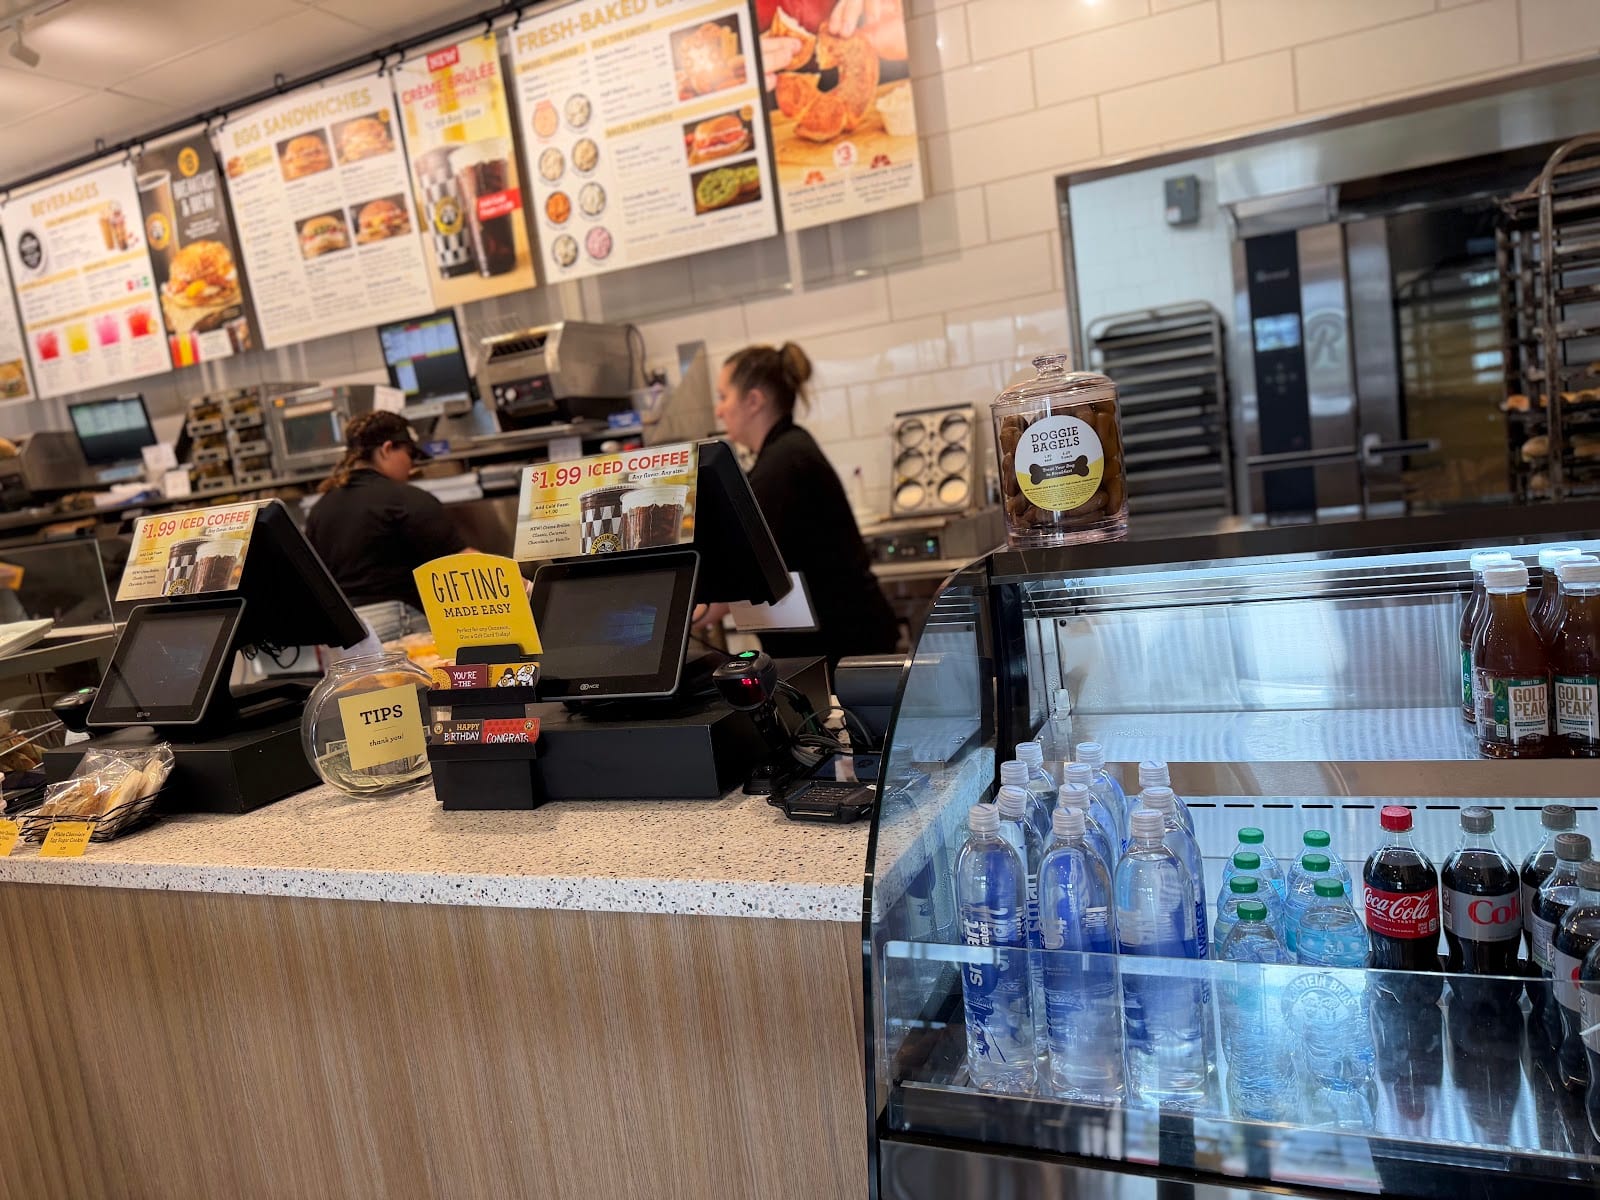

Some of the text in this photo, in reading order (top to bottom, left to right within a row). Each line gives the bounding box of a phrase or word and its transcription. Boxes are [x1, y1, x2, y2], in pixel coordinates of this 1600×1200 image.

[232, 86, 372, 149] EGG SANDWICHES
[31, 181, 99, 218] BEVERAGES
[1031, 426, 1079, 443] DOGGIE
[1032, 437, 1080, 453] BAGELS
[531, 450, 690, 489] $1.99 ICED COFFEE
[143, 510, 250, 539] $1.99 ICED COFFEE
[431, 567, 510, 603] GIFTING
[443, 603, 511, 617] MADE EASY
[453, 670, 478, 680] YOU'RE
[1513, 687, 1545, 702] GOLD
[1558, 685, 1593, 702] GOLD
[360, 704, 403, 725] TIPS
[1513, 700, 1546, 717] PEAK
[1559, 700, 1592, 715] PEAK
[456, 723, 480, 731] HAPPY
[369, 732, 404, 747] thank you!
[486, 731, 529, 744] CONGRATS
[1364, 887, 1433, 920] Coca-Cola
[1467, 896, 1521, 925] Cok
